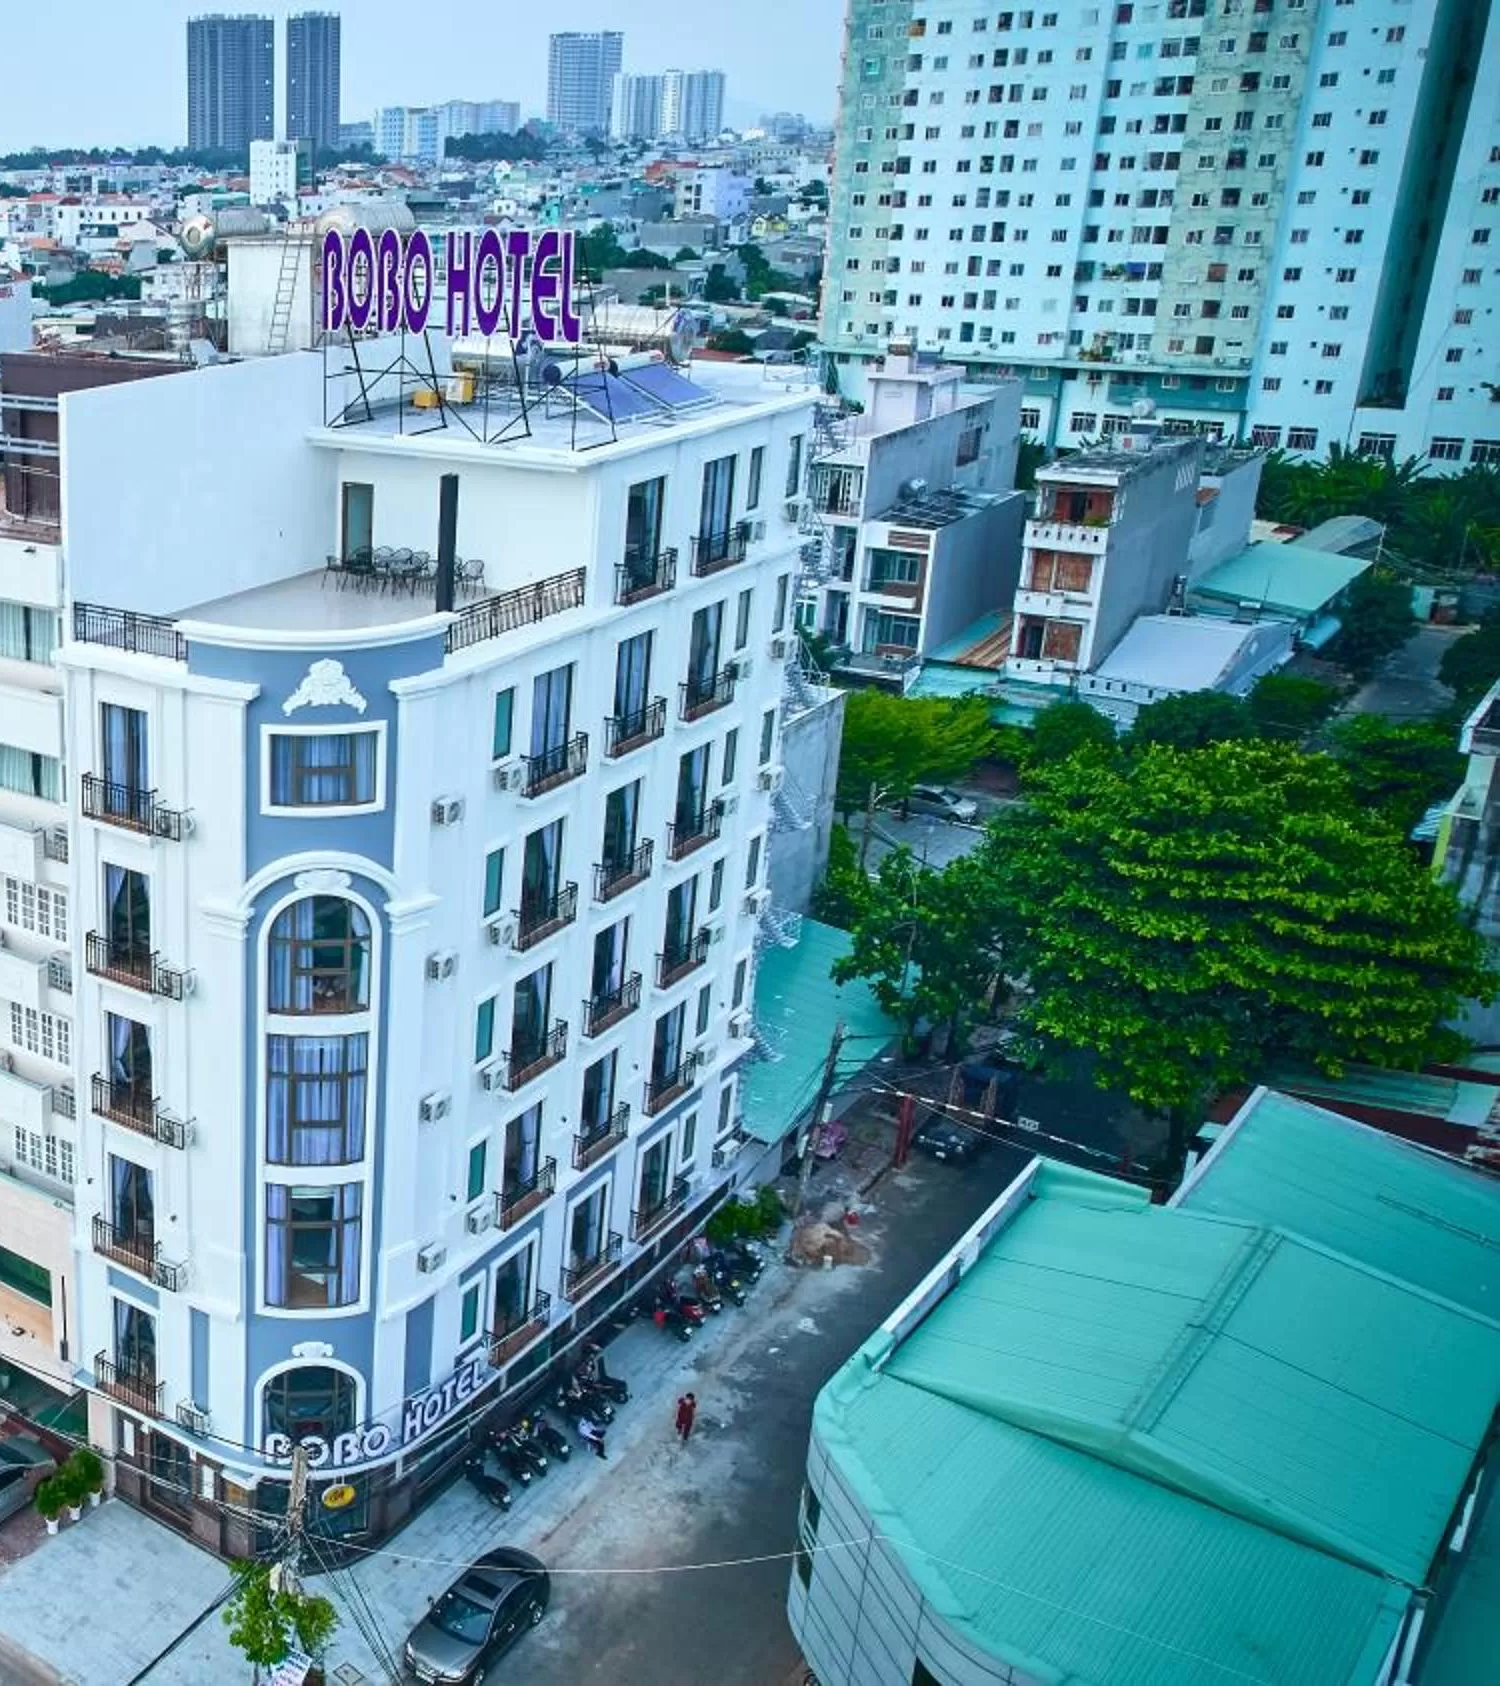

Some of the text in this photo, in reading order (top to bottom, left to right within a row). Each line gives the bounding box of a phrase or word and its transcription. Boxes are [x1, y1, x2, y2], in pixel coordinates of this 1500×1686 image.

[323, 227, 582, 343] BOBO HOTEL
[264, 1359, 484, 1467] BOBO HOTEL
